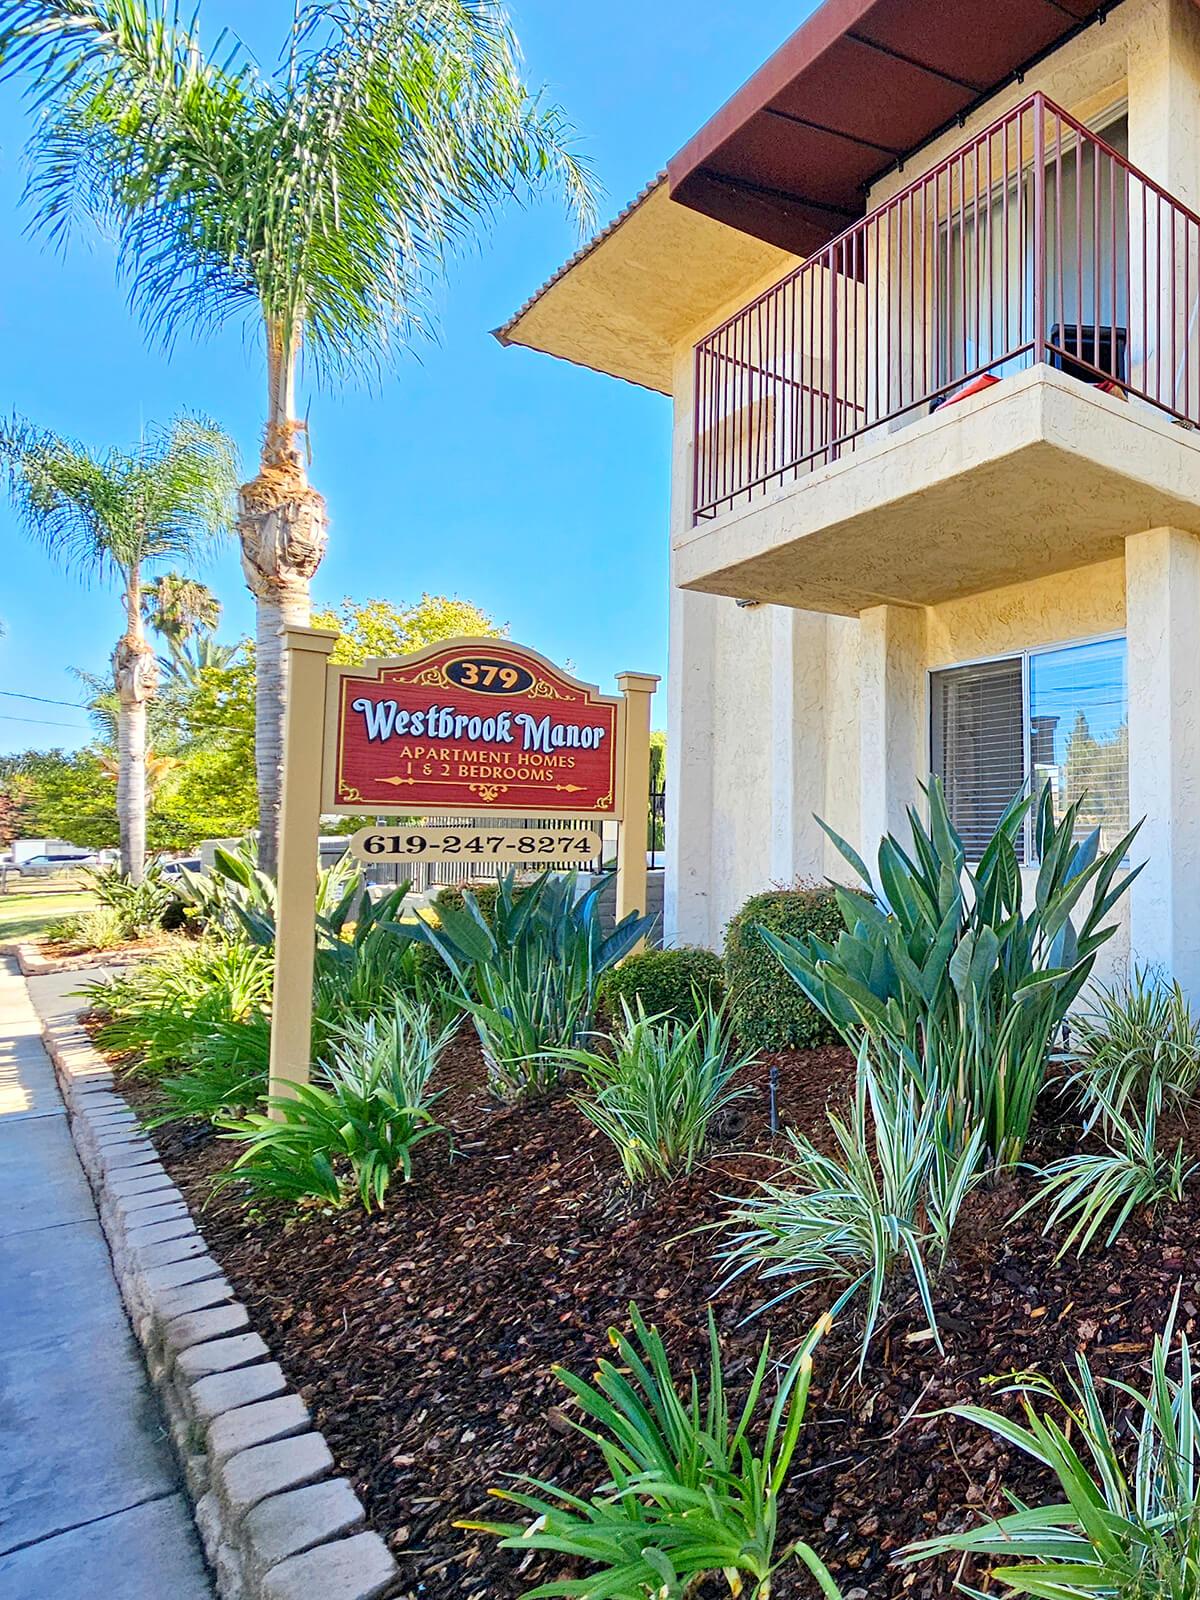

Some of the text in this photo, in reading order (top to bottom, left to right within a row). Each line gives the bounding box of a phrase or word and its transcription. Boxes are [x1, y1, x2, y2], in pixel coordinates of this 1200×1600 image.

[460, 662, 518, 689] 379
[352, 698, 605, 753] Westbrook Manor
[400, 746, 575, 768] APARTMENT HOMES
[423, 763, 432, 775] &
[440, 764, 450, 776] 2
[459, 765, 553, 781] BEDROOMS
[363, 835, 591, 854] 619-247-8274
